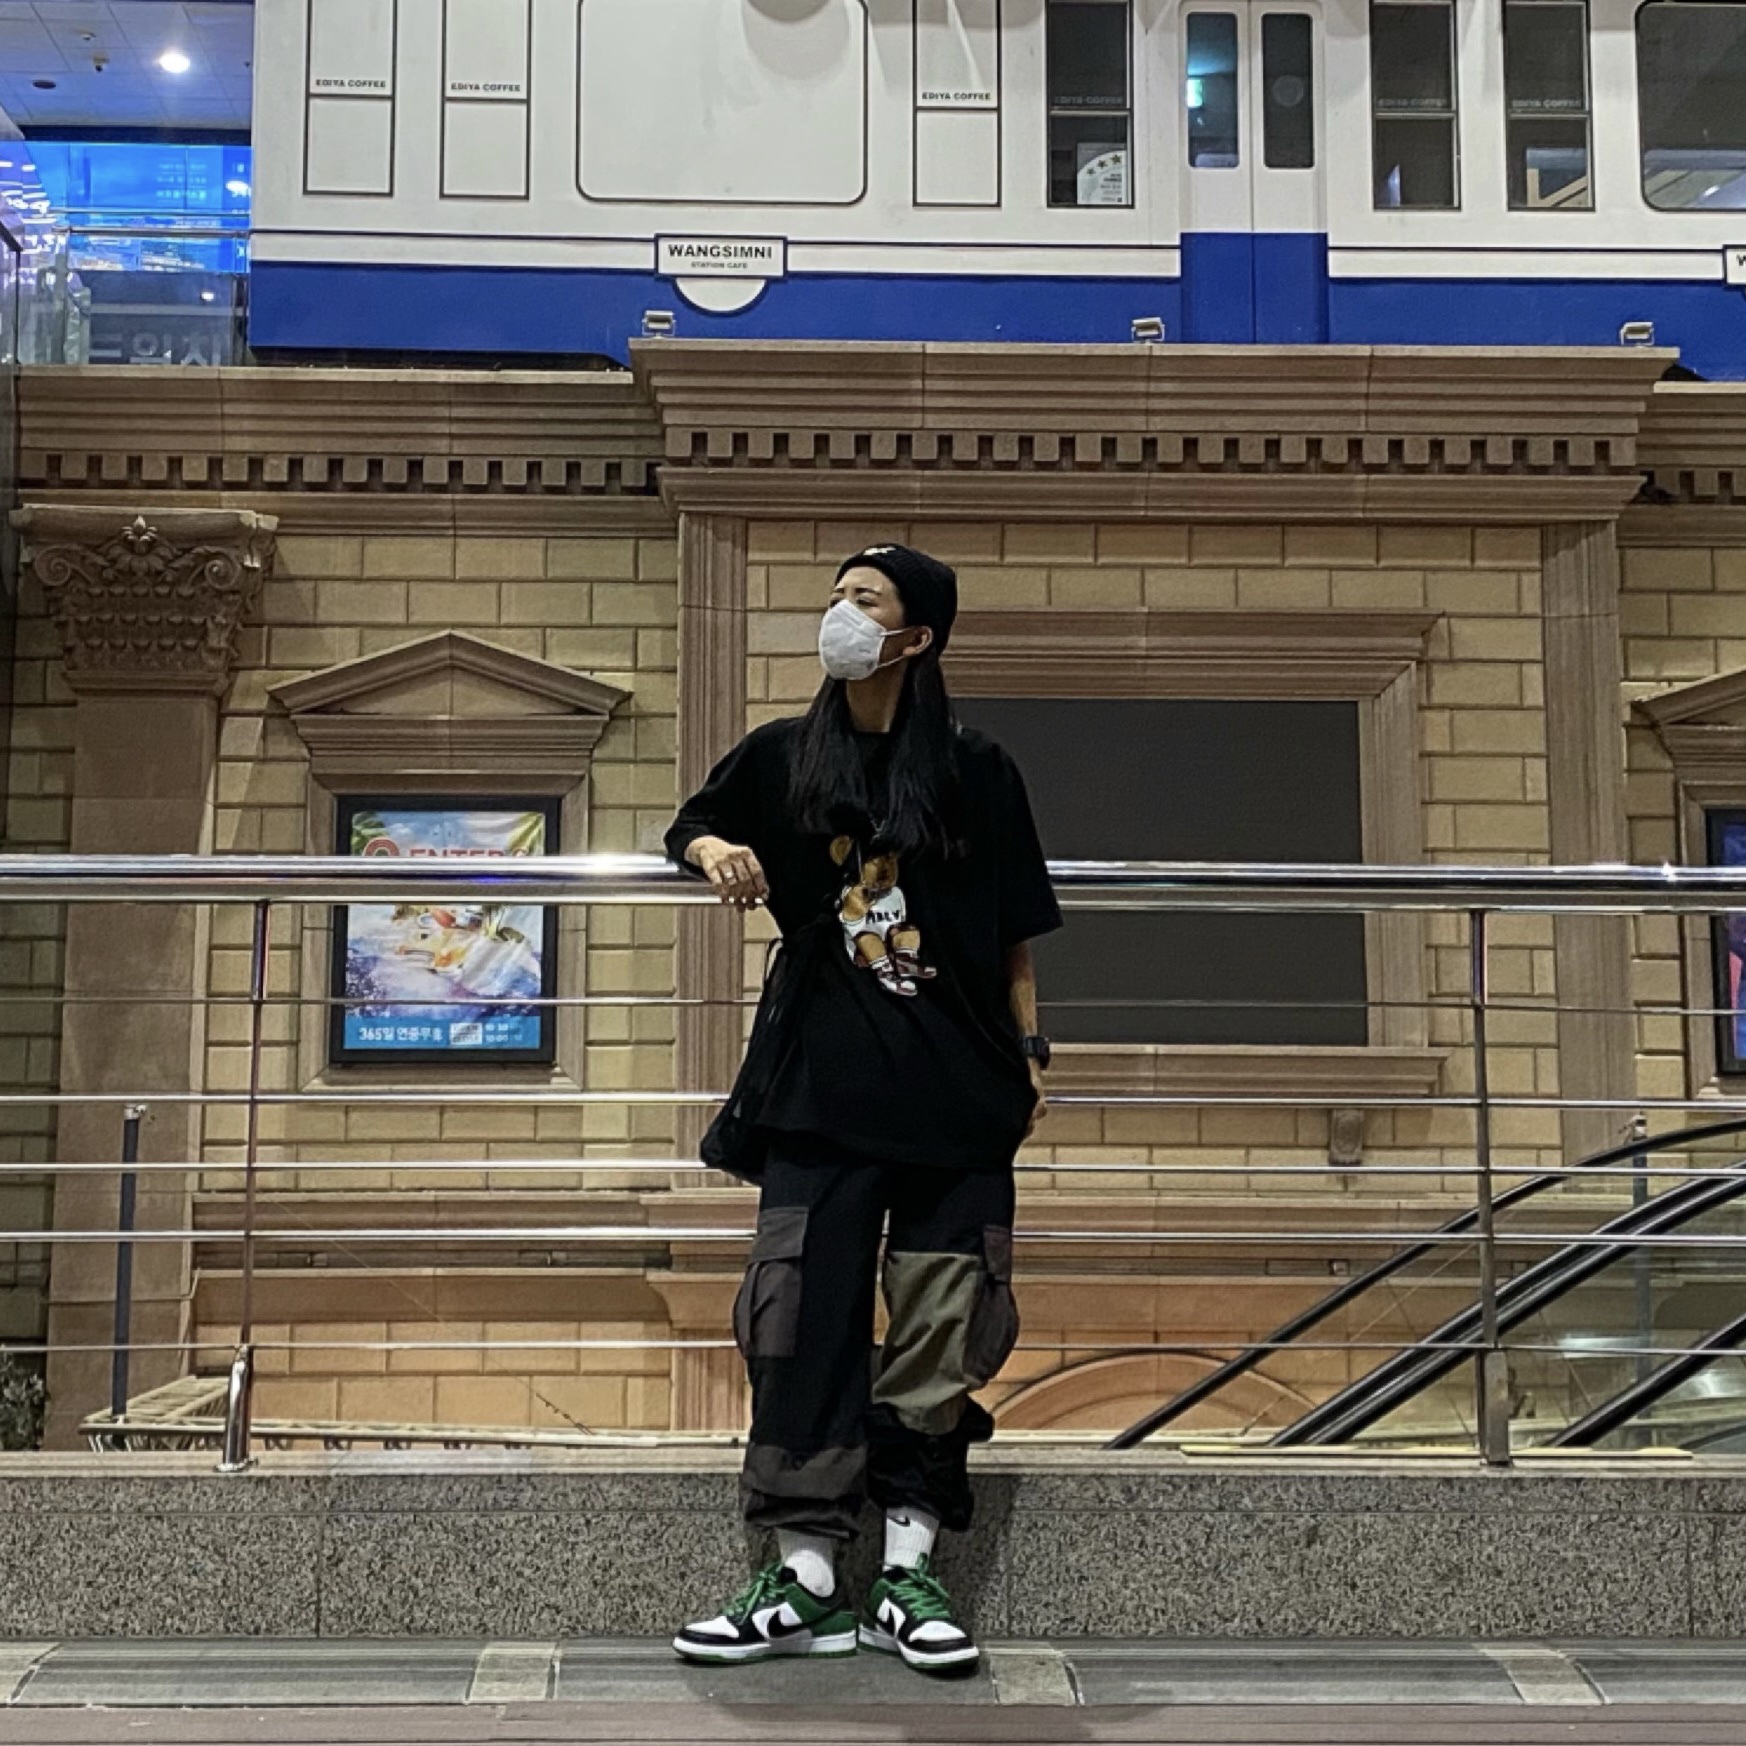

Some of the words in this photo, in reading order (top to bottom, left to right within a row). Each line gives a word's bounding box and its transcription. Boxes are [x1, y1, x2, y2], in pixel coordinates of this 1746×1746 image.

[315, 78, 346, 88] EDIYA
[347, 79, 387, 88] COFFEE
[450, 82, 481, 91] EDIYA
[482, 83, 521, 92] COFFEE
[921, 91, 951, 100] EDIYA
[953, 92, 991, 100] COFFEE
[667, 244, 773, 259] WANGSIMNI
[690, 261, 725, 269] STATION
